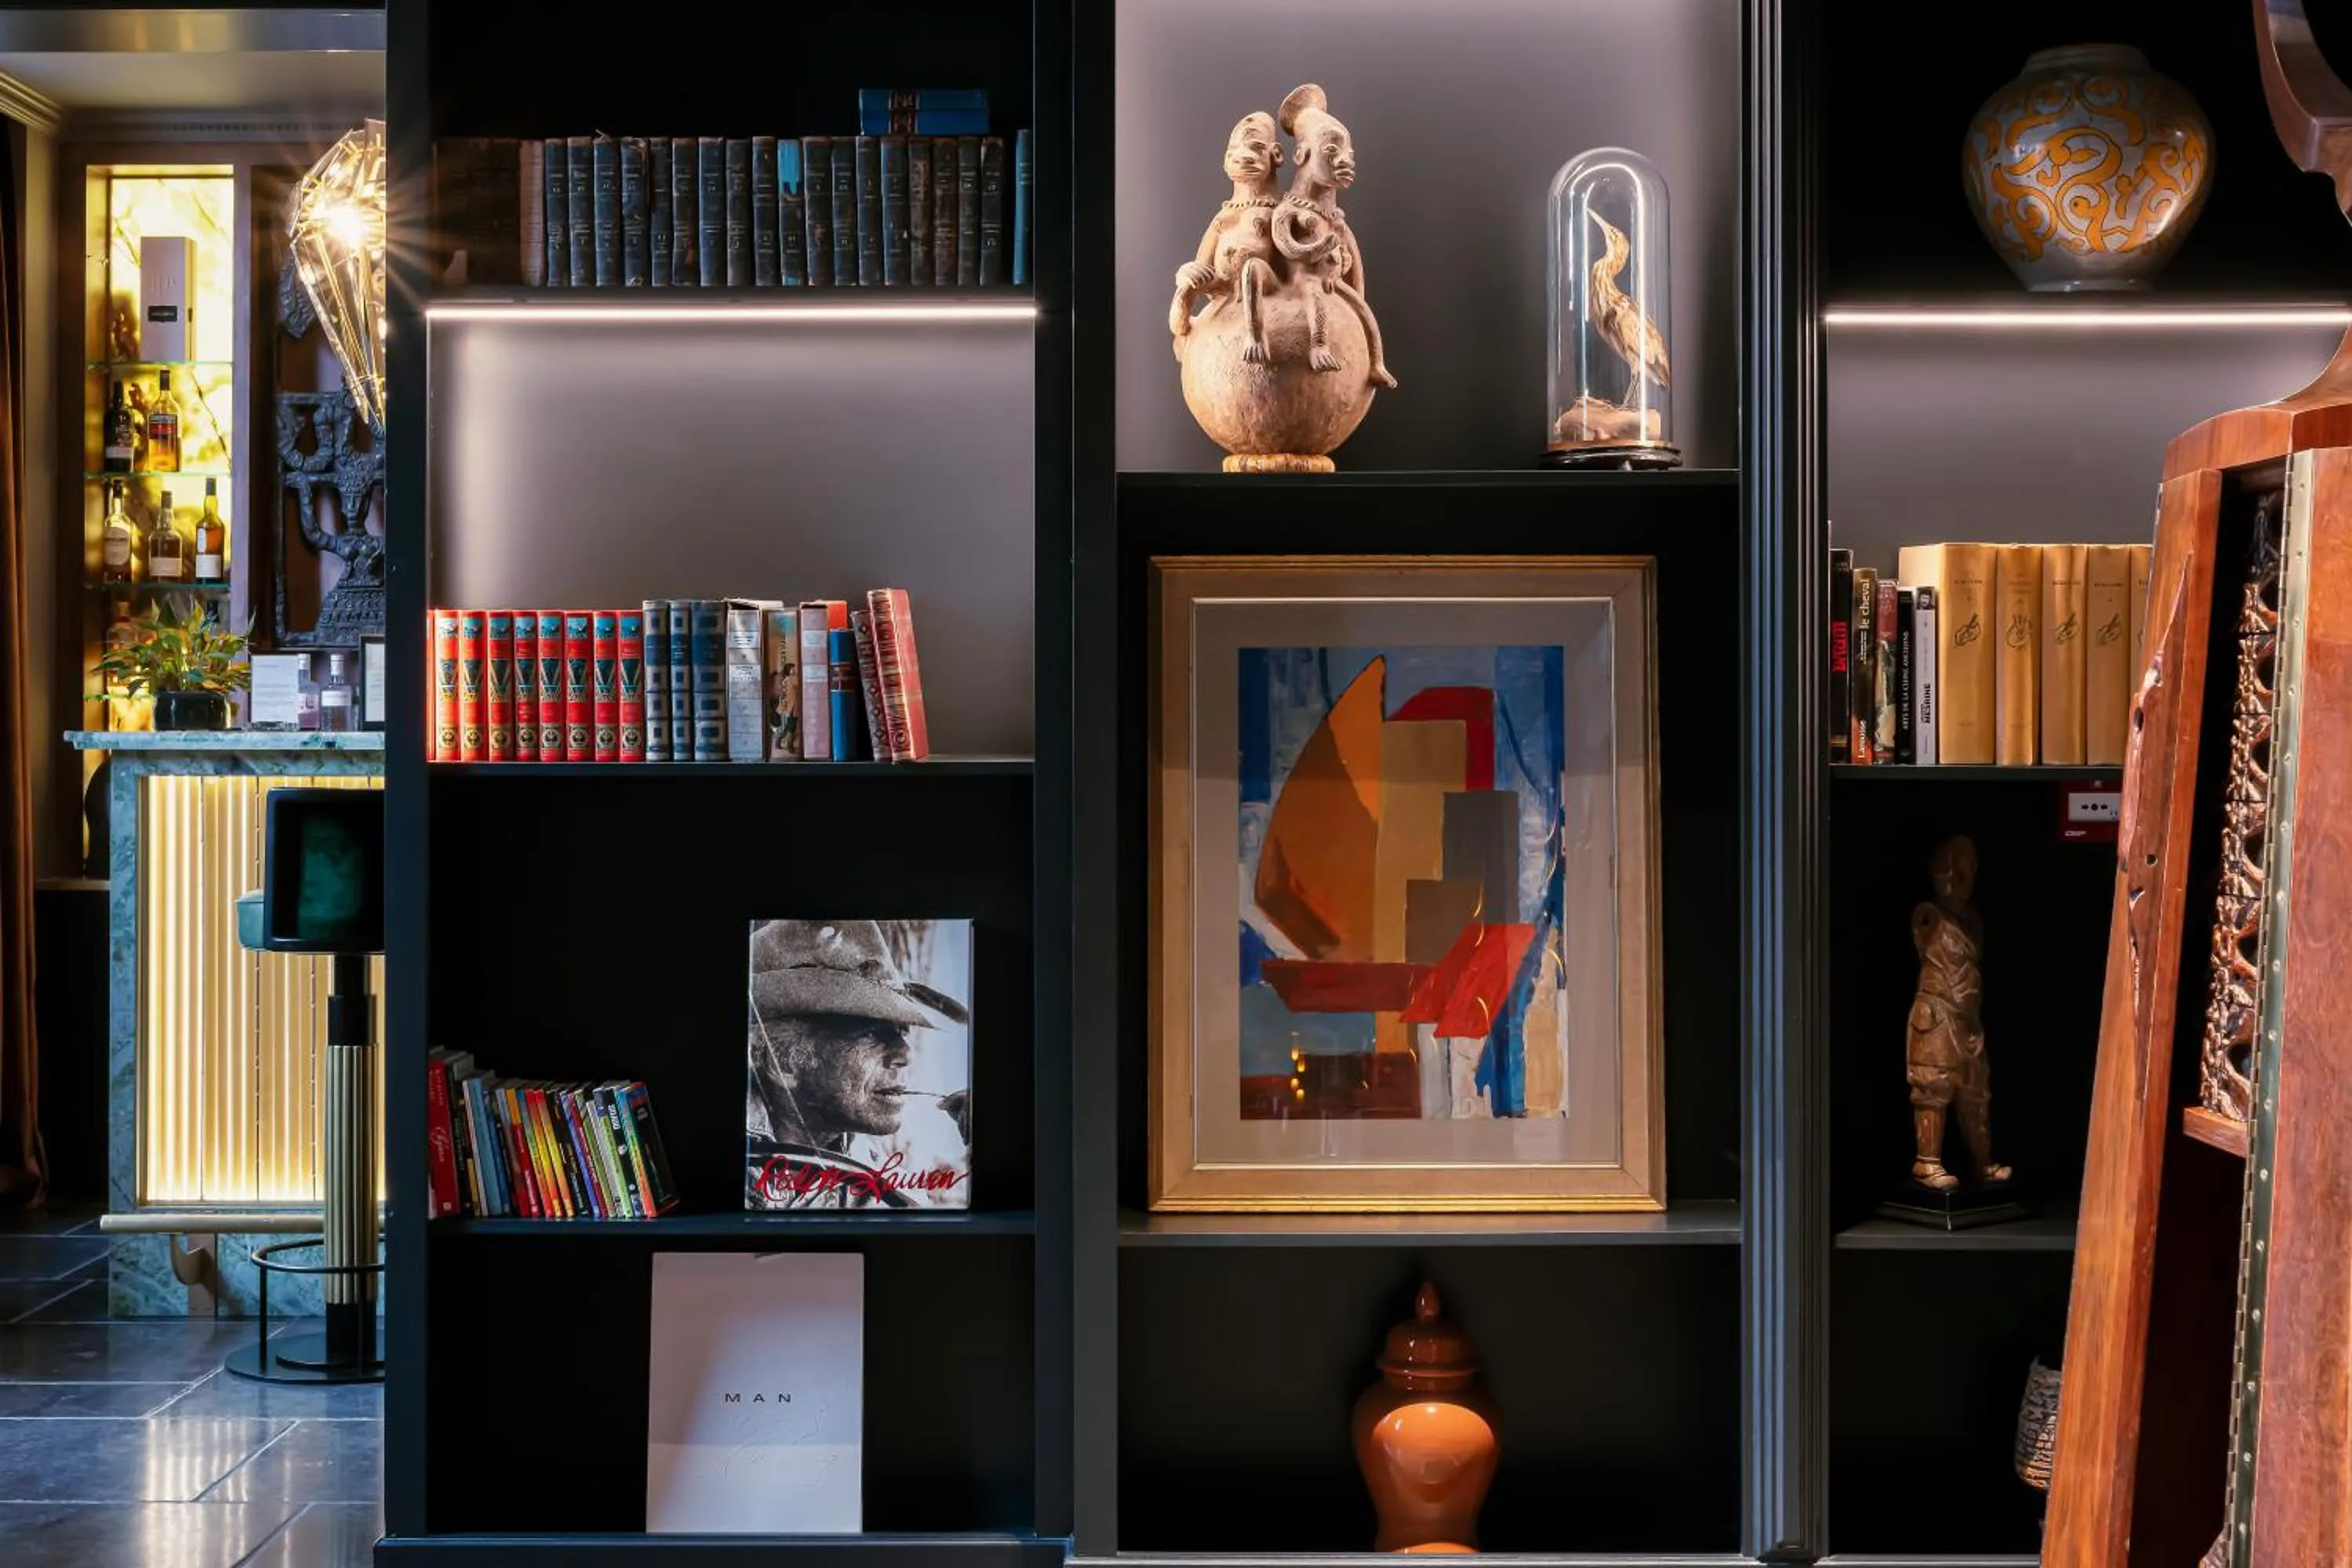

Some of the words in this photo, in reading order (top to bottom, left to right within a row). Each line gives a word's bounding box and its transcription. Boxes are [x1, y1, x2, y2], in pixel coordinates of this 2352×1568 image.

[1860, 579, 1870, 617] cheval
[1858, 720, 1867, 759] Larousse
[849, 1152, 970, 1204] Lauren
[724, 1392, 791, 1403] MAN
